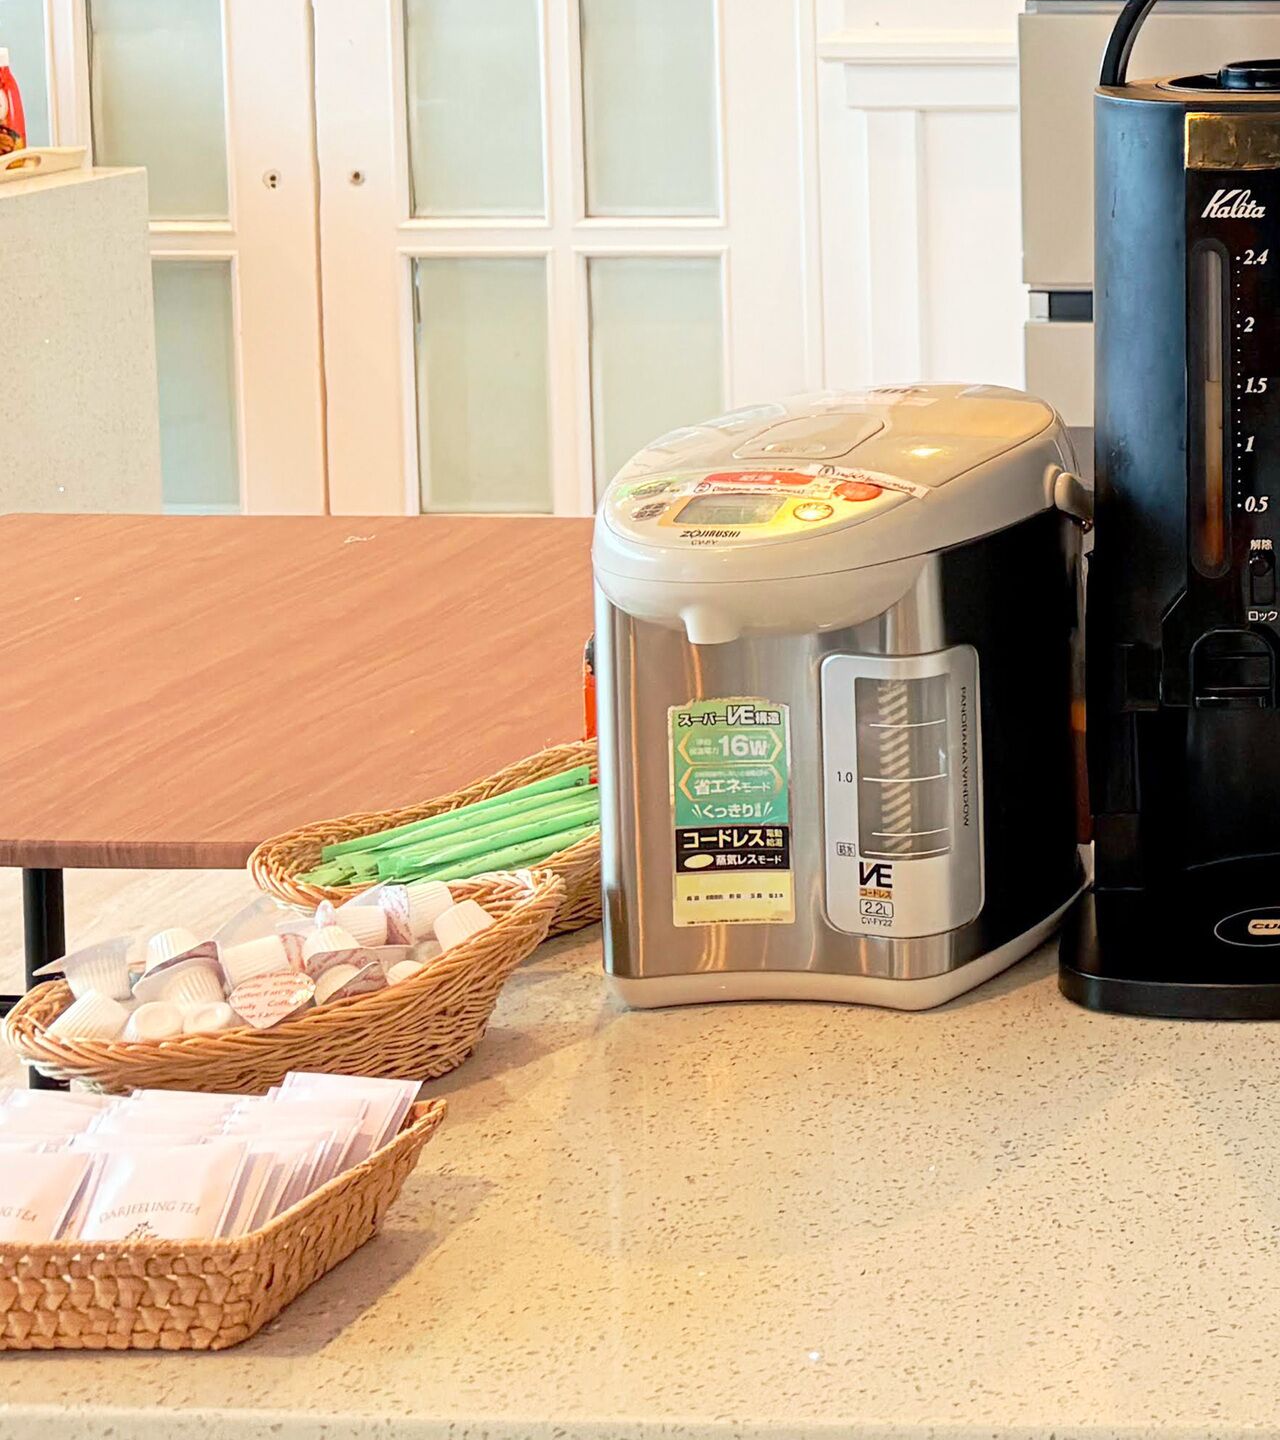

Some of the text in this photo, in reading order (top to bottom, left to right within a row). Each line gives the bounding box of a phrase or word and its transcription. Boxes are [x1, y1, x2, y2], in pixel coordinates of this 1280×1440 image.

[1200, 189, 1266, 218] Kalita
[1243, 249, 1269, 265] 2.4
[1243, 317, 1255, 333] 2
[1244, 377, 1268, 393] 1.5
[1244, 435, 1255, 452] 1
[1244, 496, 1269, 512] 0.5
[680, 529, 740, 538] ZOJIRUSHI
[1250, 539, 1273, 550] 解除
[1248, 611, 1278, 621] ロック
[960, 686, 970, 827] PANORAMA WINDOW
[837, 771, 853, 783] 1.0
[694, 779, 771, 795] 省エネモード
[683, 829, 765, 848] コードレス
[716, 854, 782, 866] 蒸気レスモード
[859, 861, 893, 888] VE
[860, 889, 893, 900] コードレス
[865, 902, 889, 916] 2.2L
[861, 916, 893, 927] CV-FY22
[100, 1200, 201, 1223] DARJEELING TEA
